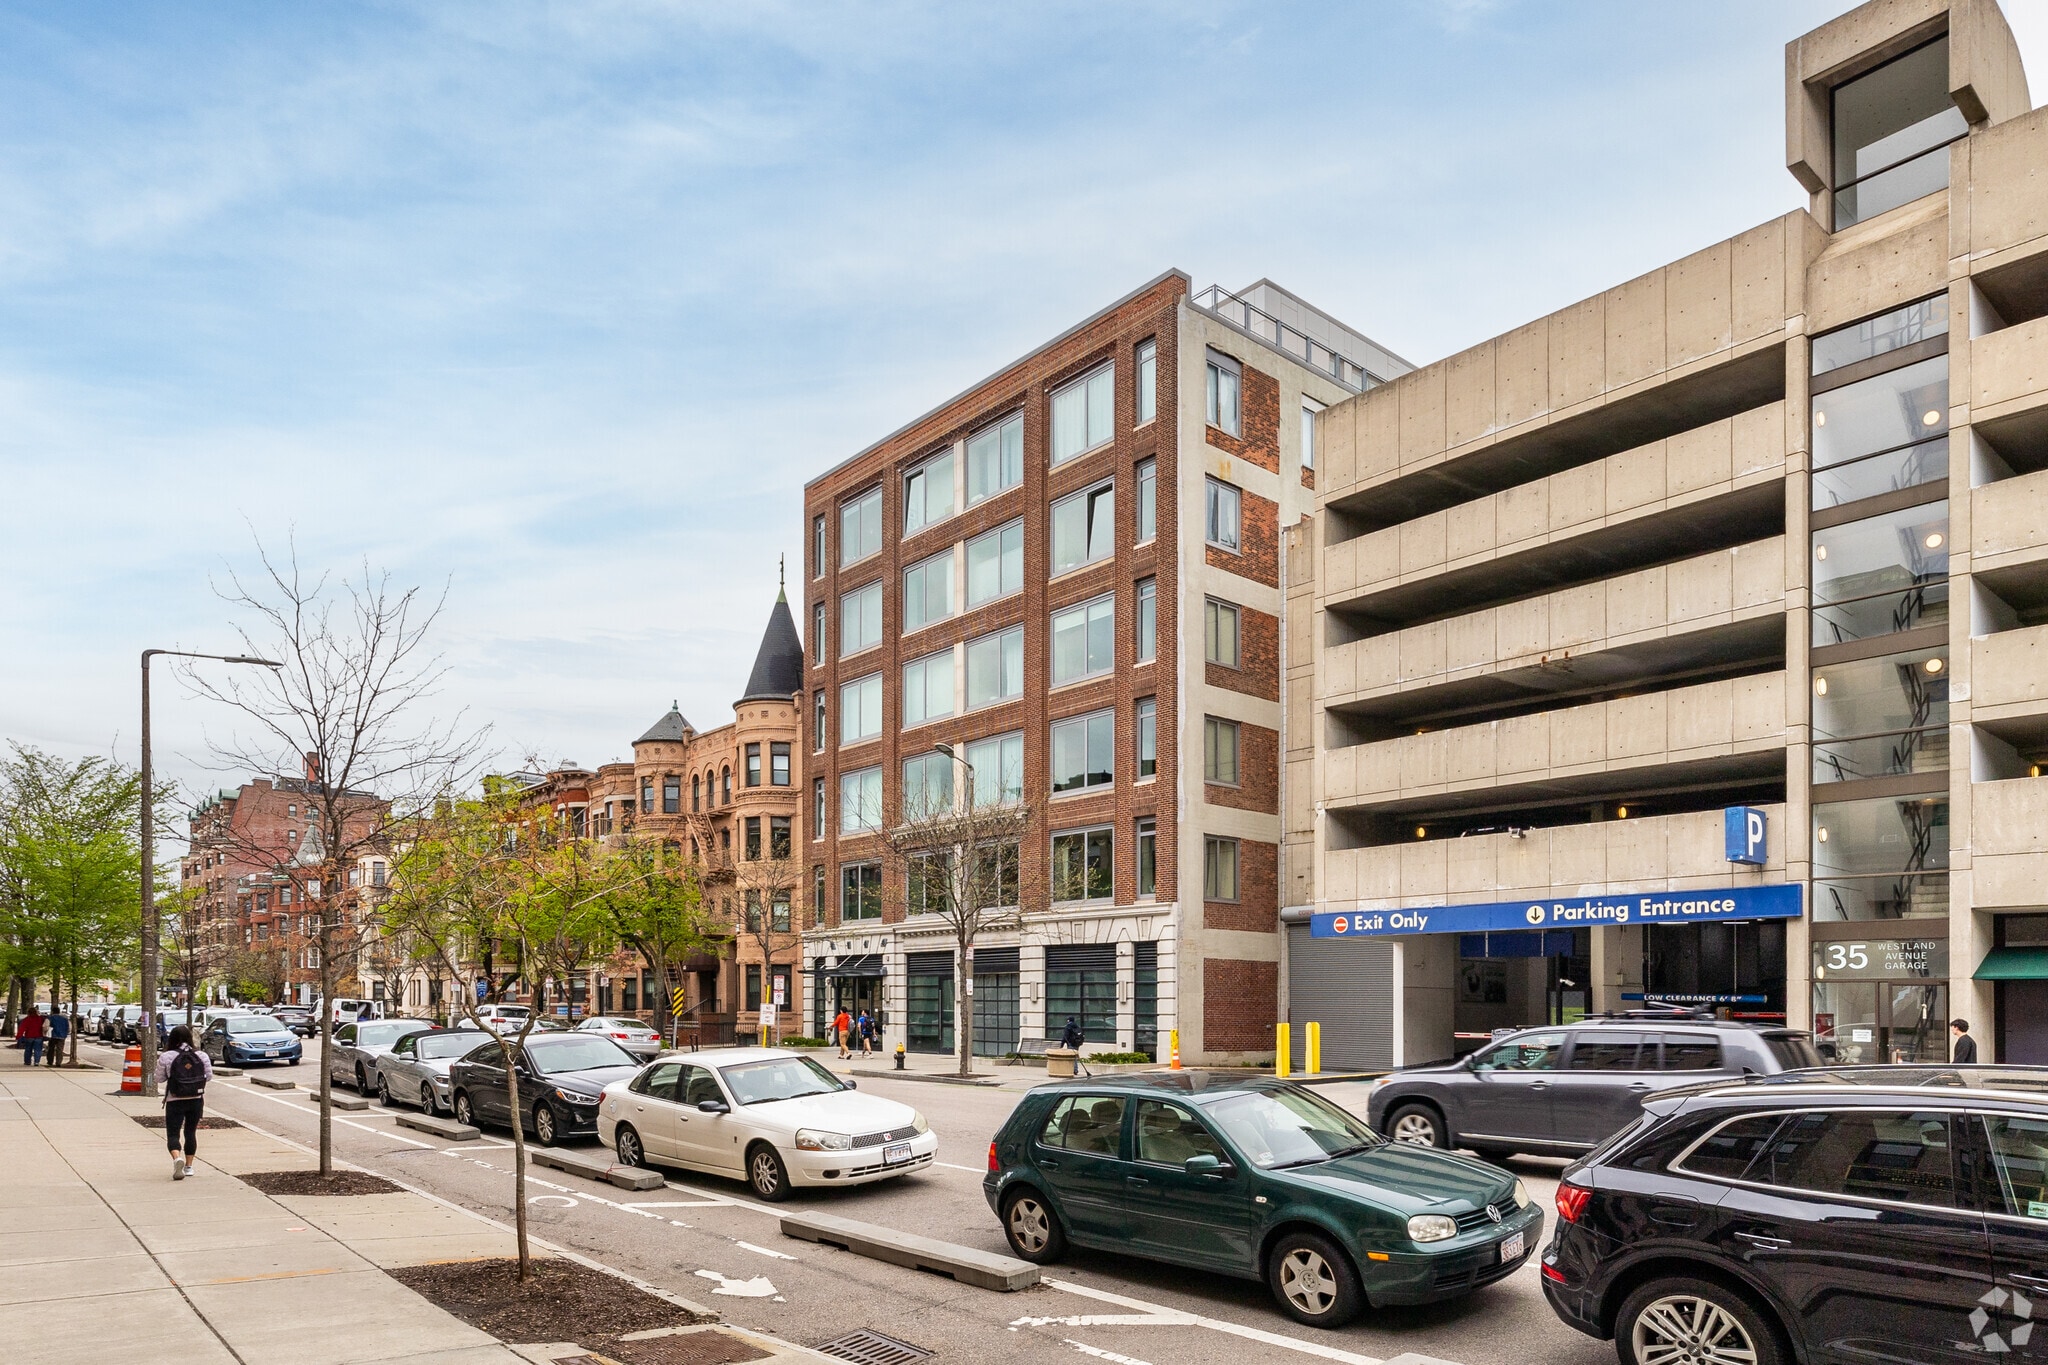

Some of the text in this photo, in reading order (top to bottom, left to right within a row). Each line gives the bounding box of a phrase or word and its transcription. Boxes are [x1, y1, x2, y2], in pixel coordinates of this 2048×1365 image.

[1747, 812, 1763, 856] P
[1553, 898, 1736, 922] Parking Entrance
[1355, 911, 1428, 931] Exit Only
[1878, 942, 1936, 950] WESTLAND
[1885, 951, 1928, 960] AVENUE
[1827, 944, 1869, 970] 35
[1884, 961, 1928, 970] GARAGE
